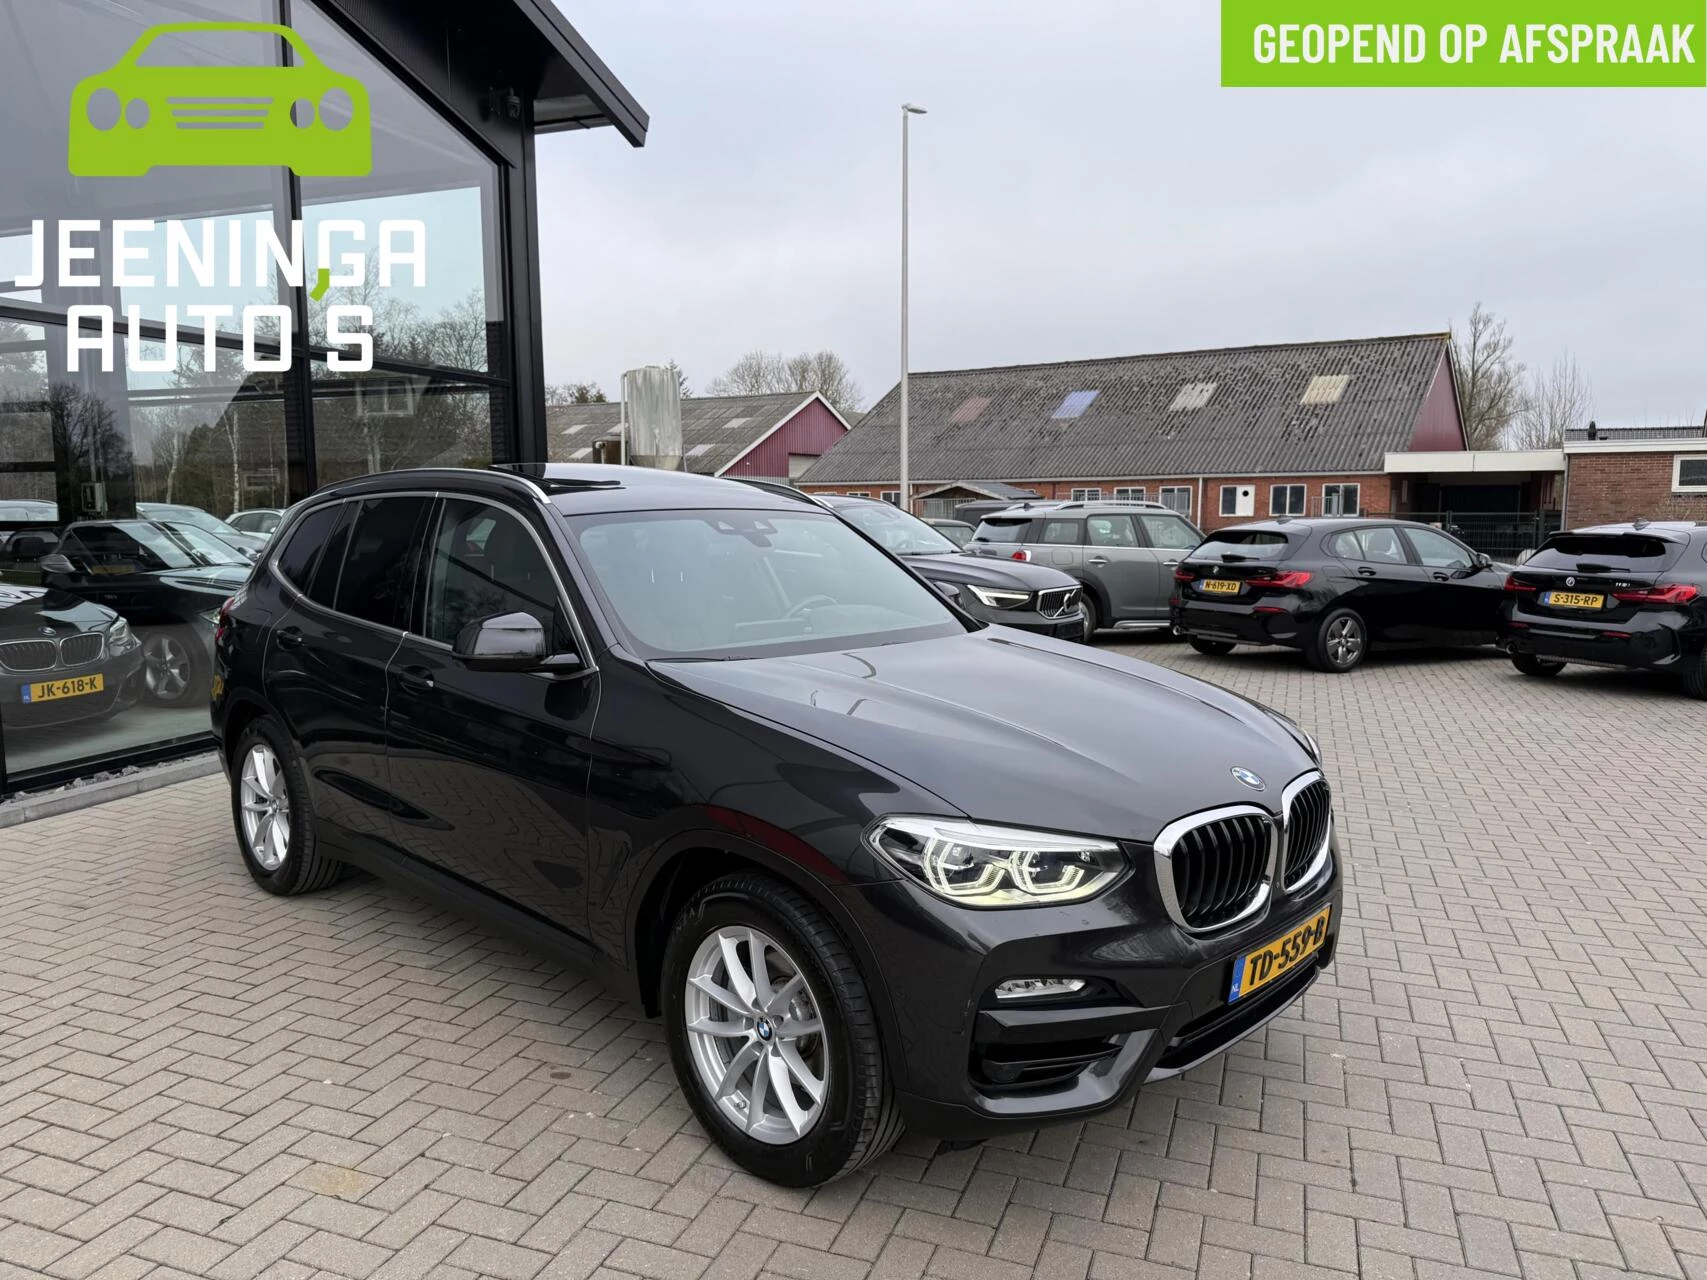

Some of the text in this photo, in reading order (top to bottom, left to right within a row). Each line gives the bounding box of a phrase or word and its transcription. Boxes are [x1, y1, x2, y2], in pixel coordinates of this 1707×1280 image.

[1205, 581, 1238, 591] N-619-XD
[1553, 593, 1598, 606] S-315-RP
[37, 676, 98, 699] JK-618-K
[1249, 915, 1326, 986] TD-559-B
